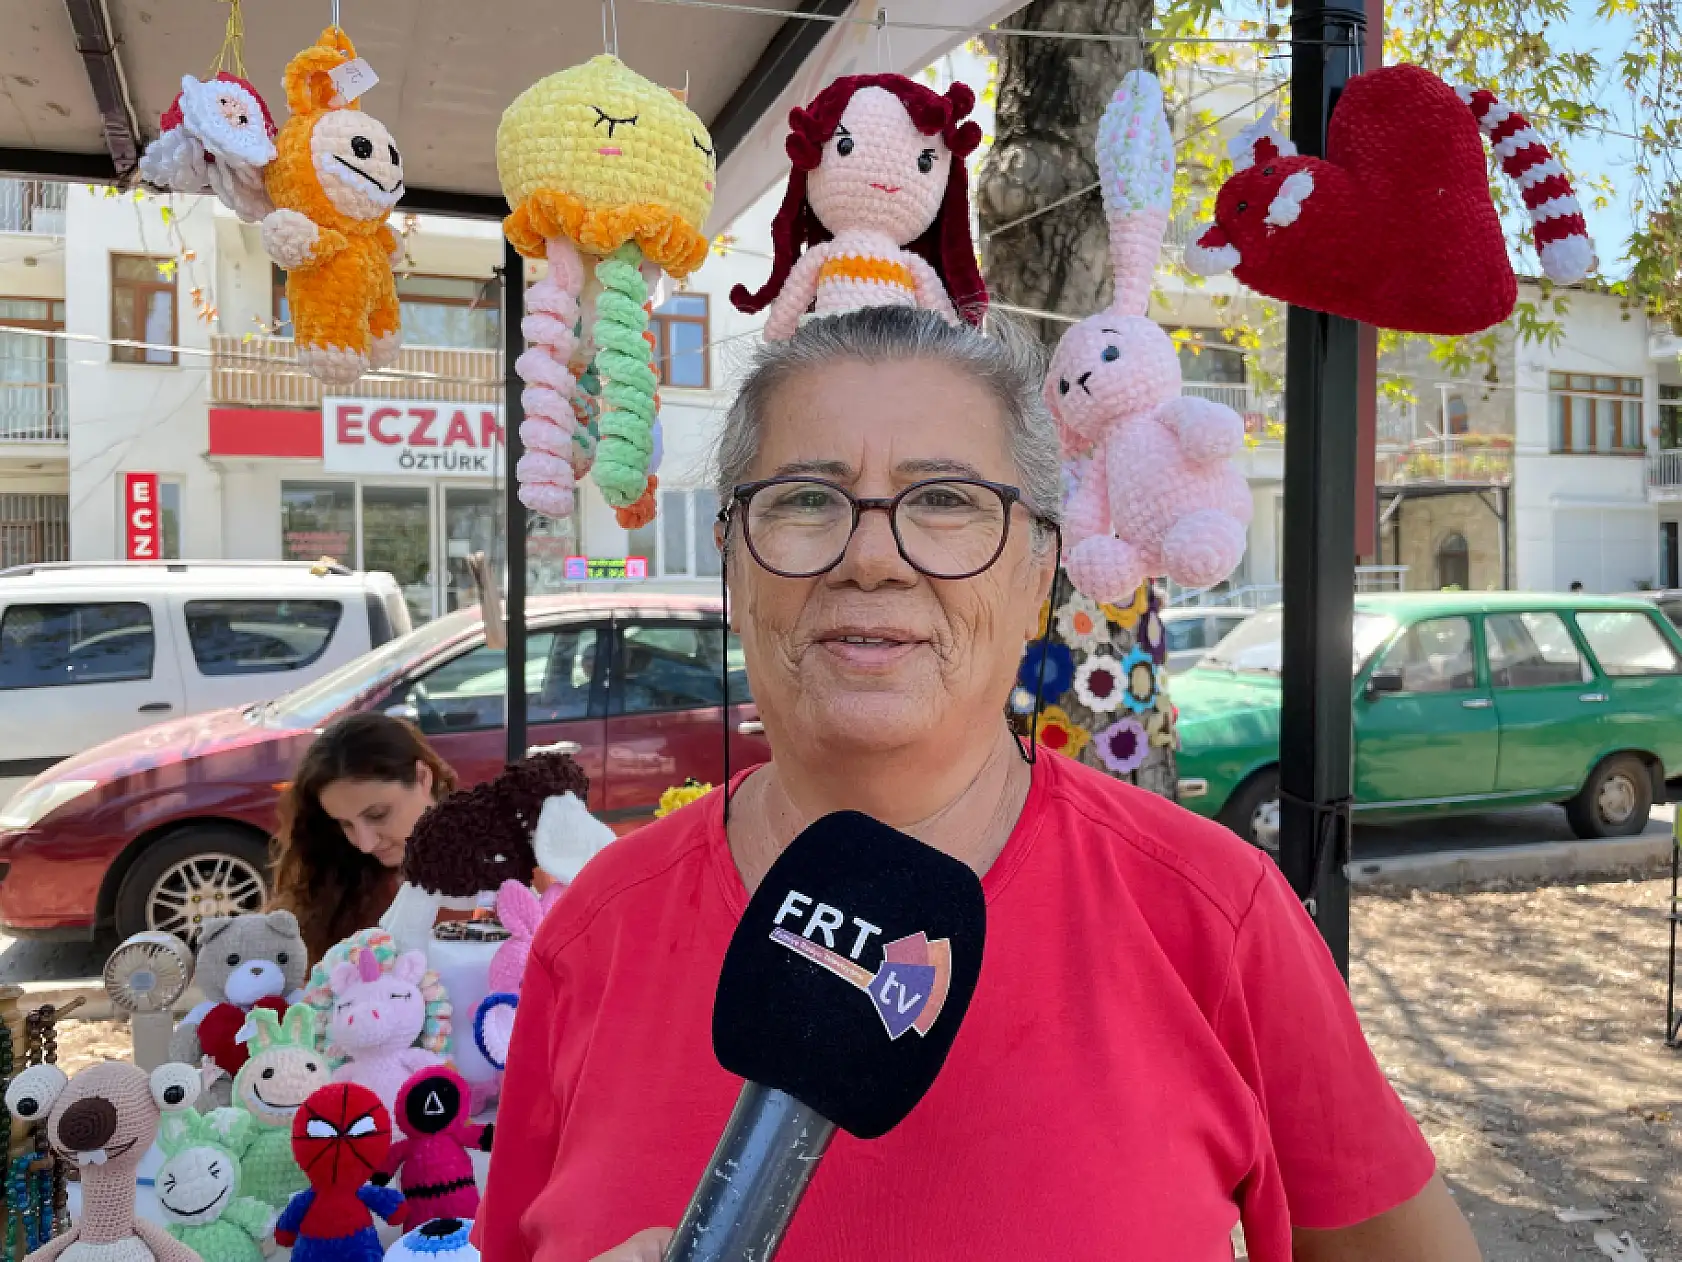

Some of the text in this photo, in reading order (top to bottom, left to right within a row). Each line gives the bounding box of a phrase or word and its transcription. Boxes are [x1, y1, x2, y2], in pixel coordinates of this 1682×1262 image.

[399, 449, 487, 471] ÖZTÜRK
[132, 481, 153, 556] ECZ
[773, 890, 883, 960] FRT
[879, 970, 923, 1015] tv
